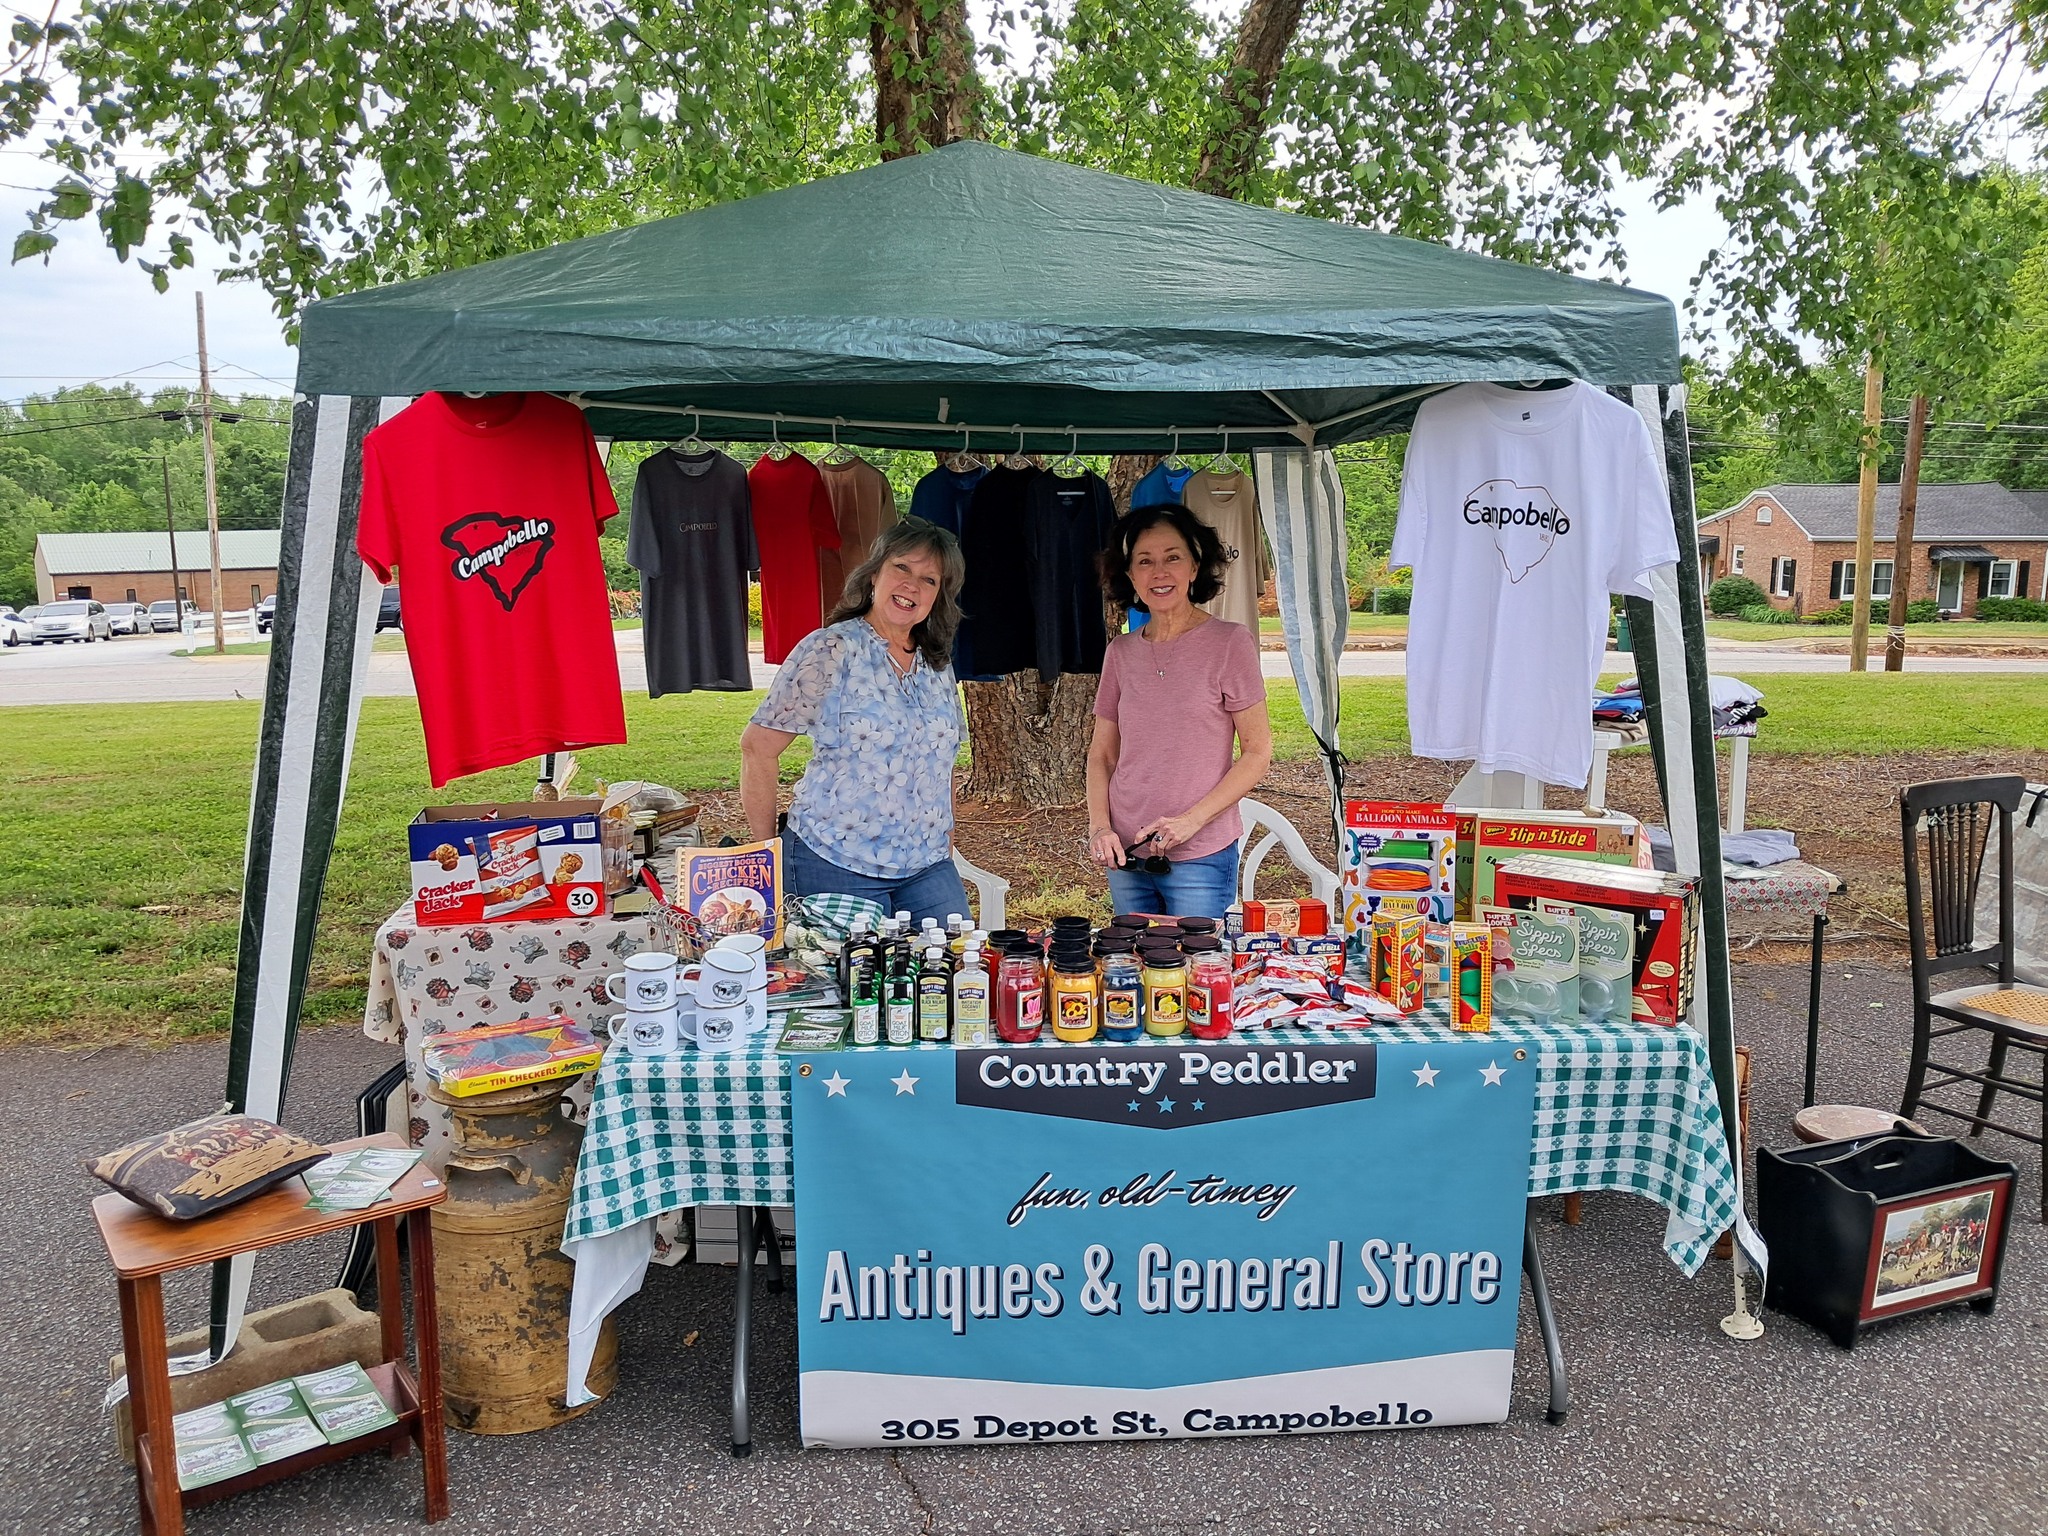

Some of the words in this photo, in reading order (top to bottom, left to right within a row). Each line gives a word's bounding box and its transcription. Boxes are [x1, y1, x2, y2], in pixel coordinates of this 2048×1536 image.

[458, 518, 549, 579] Campobello
[1355, 812, 1402, 823] BALLOON
[1404, 814, 1448, 825] ANIMALS
[1550, 830, 1587, 847] Slide
[491, 852, 527, 871] Cracker
[498, 861, 521, 877] Jack
[697, 860, 733, 871] BIGGEST
[734, 858, 757, 867] BOOK
[757, 857, 768, 865] OF
[418, 878, 476, 900] Cracker
[692, 865, 772, 895] CHICKEN
[712, 878, 756, 892] RECIPES
[423, 895, 464, 914] Jack
[571, 892, 594, 906] 30
[1486, 913, 1515, 922] SUPER-
[1546, 907, 1574, 915] SUPER-
[1390, 926, 1397, 937] 3
[1516, 920, 1566, 945] Sippin'
[1479, 940, 1488, 952] 3
[1516, 940, 1562, 958] Specs
[489, 1077, 507, 1088] TIN
[508, 1066, 558, 1084] CHECKERS
[978, 1053, 1168, 1095] Country
[1179, 1051, 1357, 1086] Peddler
[1006, 1172, 1092, 1227] fun,
[1098, 1170, 1298, 1221] old-timey
[819, 1249, 1066, 1335] Antiques
[1080, 1243, 1121, 1315] &
[1137, 1240, 1342, 1314] General
[1357, 1238, 1503, 1307] Store
[881, 1419, 961, 1442] 305
[973, 1412, 1099, 1441] Depot
[1112, 1410, 1169, 1439] St,
[1182, 1403, 1434, 1435] Campobello
